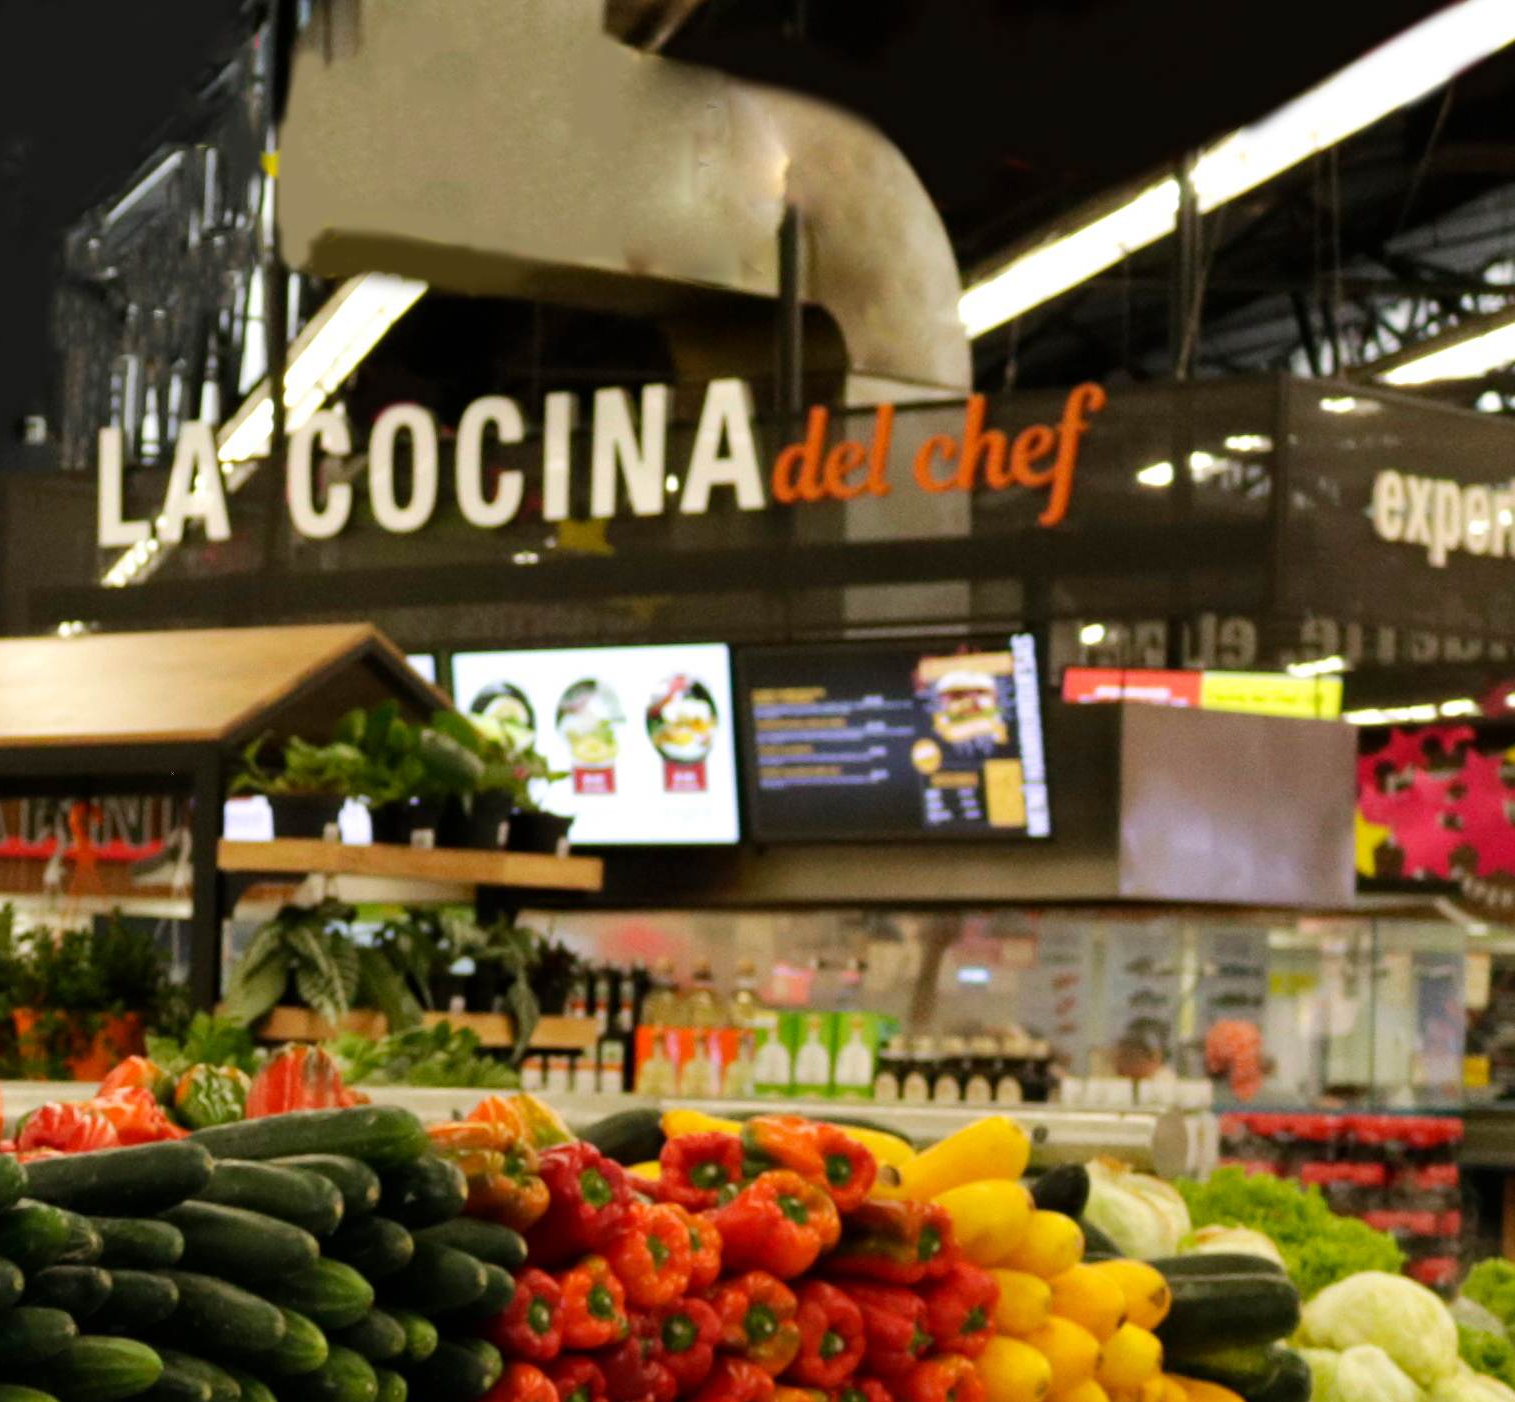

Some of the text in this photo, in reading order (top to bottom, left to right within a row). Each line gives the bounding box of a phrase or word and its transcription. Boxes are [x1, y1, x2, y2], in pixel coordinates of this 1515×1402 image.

[97, 377, 1106, 549] LA COCINA del chef
[1372, 468, 1515, 568] exper
